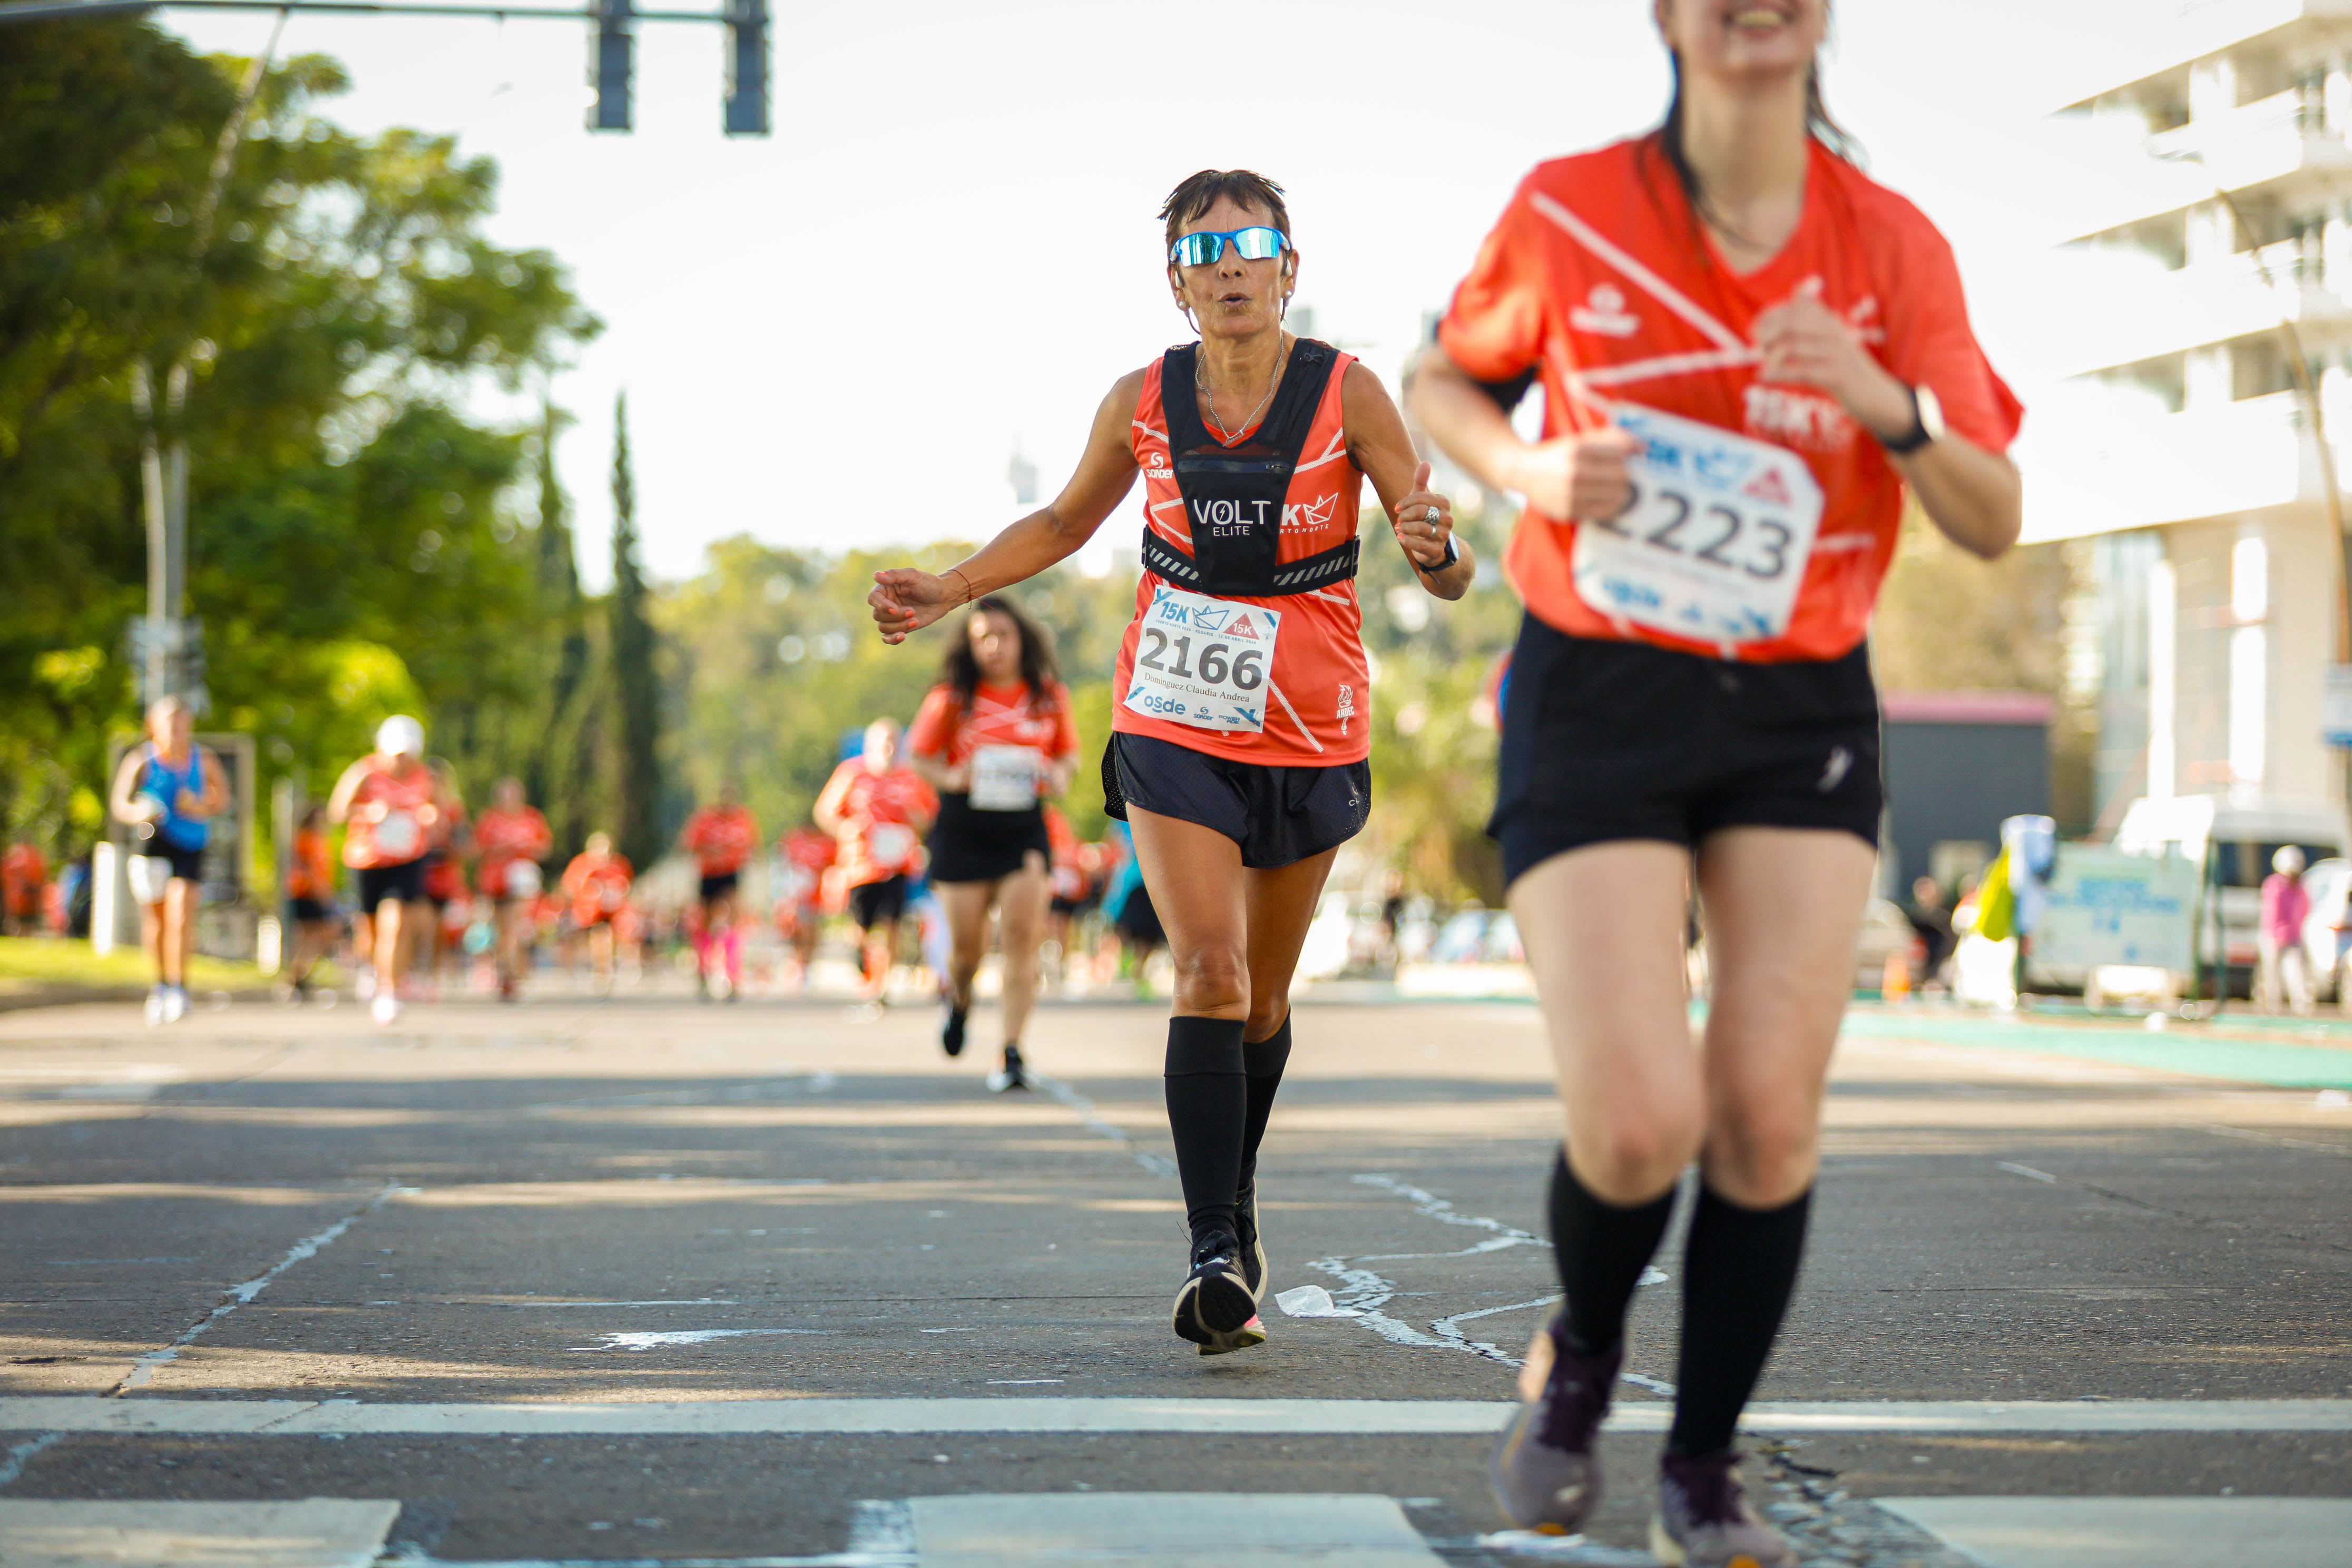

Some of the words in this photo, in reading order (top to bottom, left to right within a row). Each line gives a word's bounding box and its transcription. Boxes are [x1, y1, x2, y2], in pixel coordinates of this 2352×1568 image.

[1193, 499, 1271, 525] VOLT
[1213, 526, 1250, 537] ELITE
[1160, 601, 1190, 624] 15K
[1233, 623, 1252, 635] 15K
[1140, 628, 1263, 691] 2166
[1185, 684, 1217, 697] Claudia
[1219, 691, 1250, 703] Andrea
[1144, 695, 1186, 716] osde
[1336, 705, 1355, 719] ARDEC
